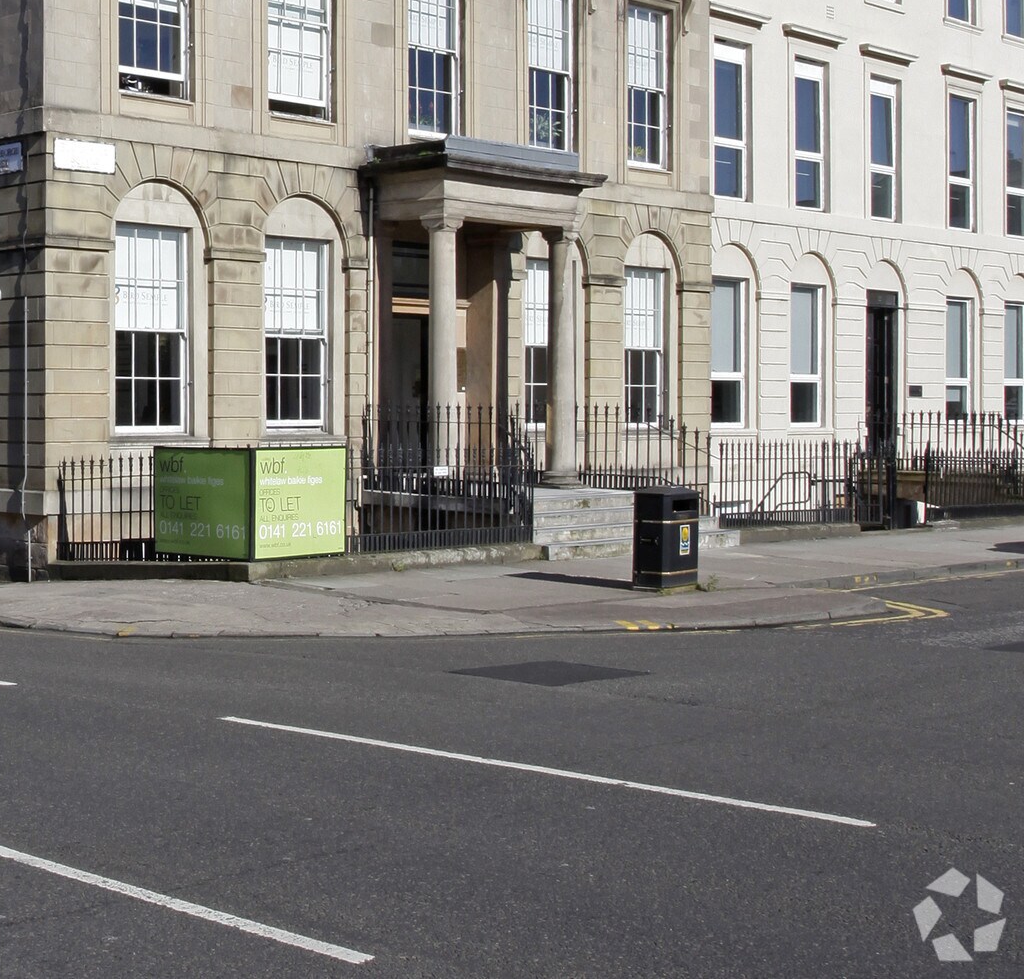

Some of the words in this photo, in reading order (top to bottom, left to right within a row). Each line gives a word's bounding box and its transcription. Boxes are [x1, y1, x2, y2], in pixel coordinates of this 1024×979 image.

[260, 457, 287, 474] wbf.
[160, 495, 175, 510] TO
[180, 496, 201, 511] LET
[259, 497, 275, 513] TO
[280, 496, 301, 512] LET
[159, 520, 184, 535] 0141
[190, 522, 211, 537] 221
[216, 523, 246, 540] 6161
[259, 524, 285, 539] 0141
[292, 522, 312, 538] 221
[316, 520, 342, 536] 6161
